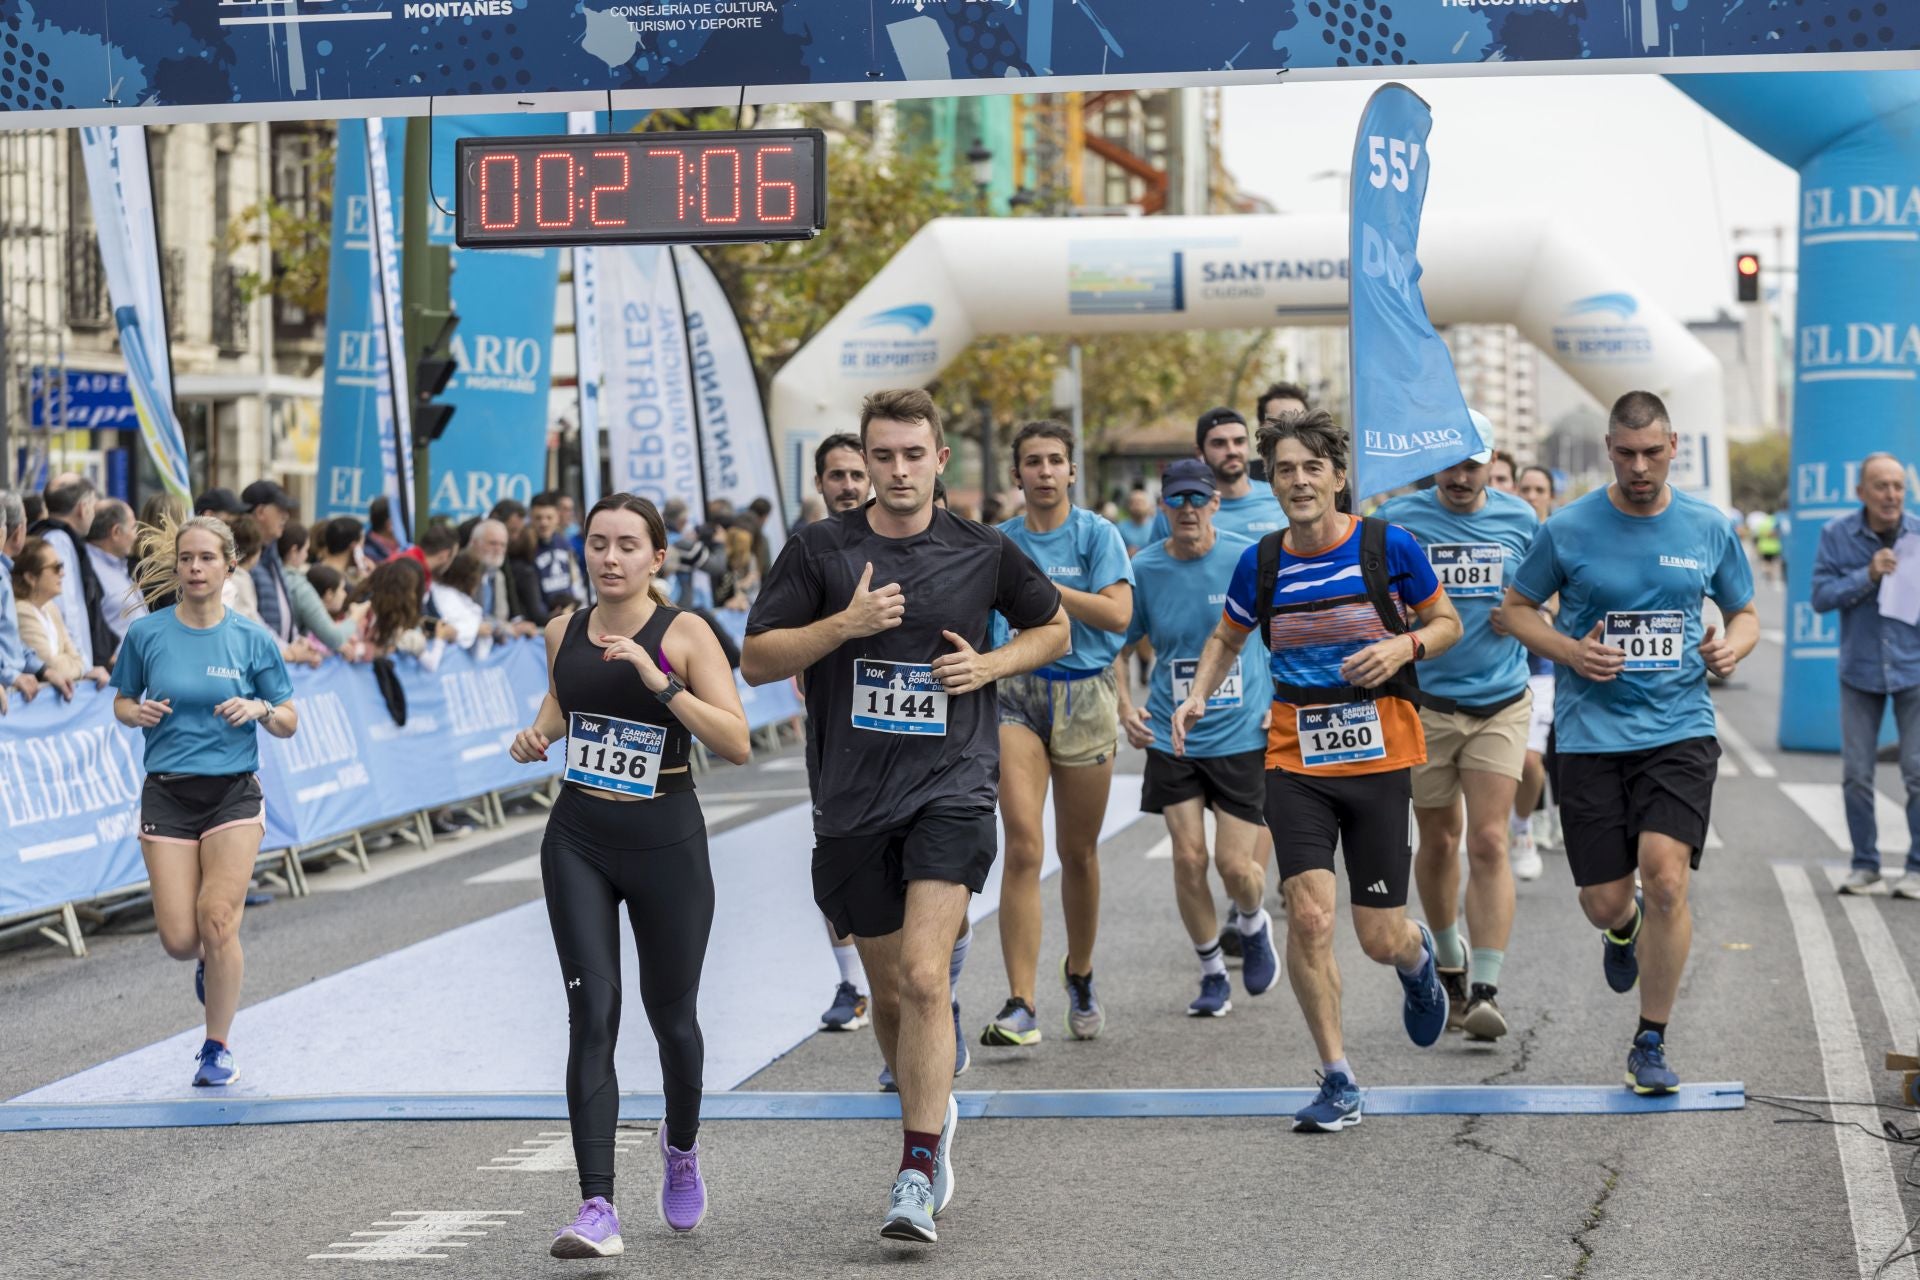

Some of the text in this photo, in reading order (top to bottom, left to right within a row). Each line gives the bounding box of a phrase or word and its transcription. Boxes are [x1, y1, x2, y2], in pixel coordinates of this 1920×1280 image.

[610, 1, 778, 17] CONSEJERÍA DE CULTURA,
[627, 17, 762, 32] TURISMO Y DEPORTE
[1803, 187, 1845, 229] EL
[1202, 259, 1349, 283] SANTANDE
[448, 333, 541, 379] ARIO
[1800, 324, 1843, 368] EL
[1364, 428, 1462, 451] EL DIARIO
[328, 465, 532, 512] EL ARIO
[1797, 462, 1839, 505] EL
[1442, 566, 1491, 584] 1081
[1613, 619, 1632, 628] 10K
[1792, 601, 1836, 643] EL
[1617, 637, 1673, 657] 1018
[218, 667, 241, 677] DIARI
[865, 668, 886, 679] 10K
[907, 677, 942, 685] POPULA
[867, 690, 935, 718] 1144
[580, 721, 601, 733] 10K
[1306, 713, 1323, 724] 10K
[620, 733, 661, 747] POPULAR
[622, 727, 663, 741] CARRERA
[1312, 726, 1372, 752] 1260
[645, 745, 659, 753] DM
[26, 720, 142, 820] DIARIO
[578, 744, 648, 779] 1136
